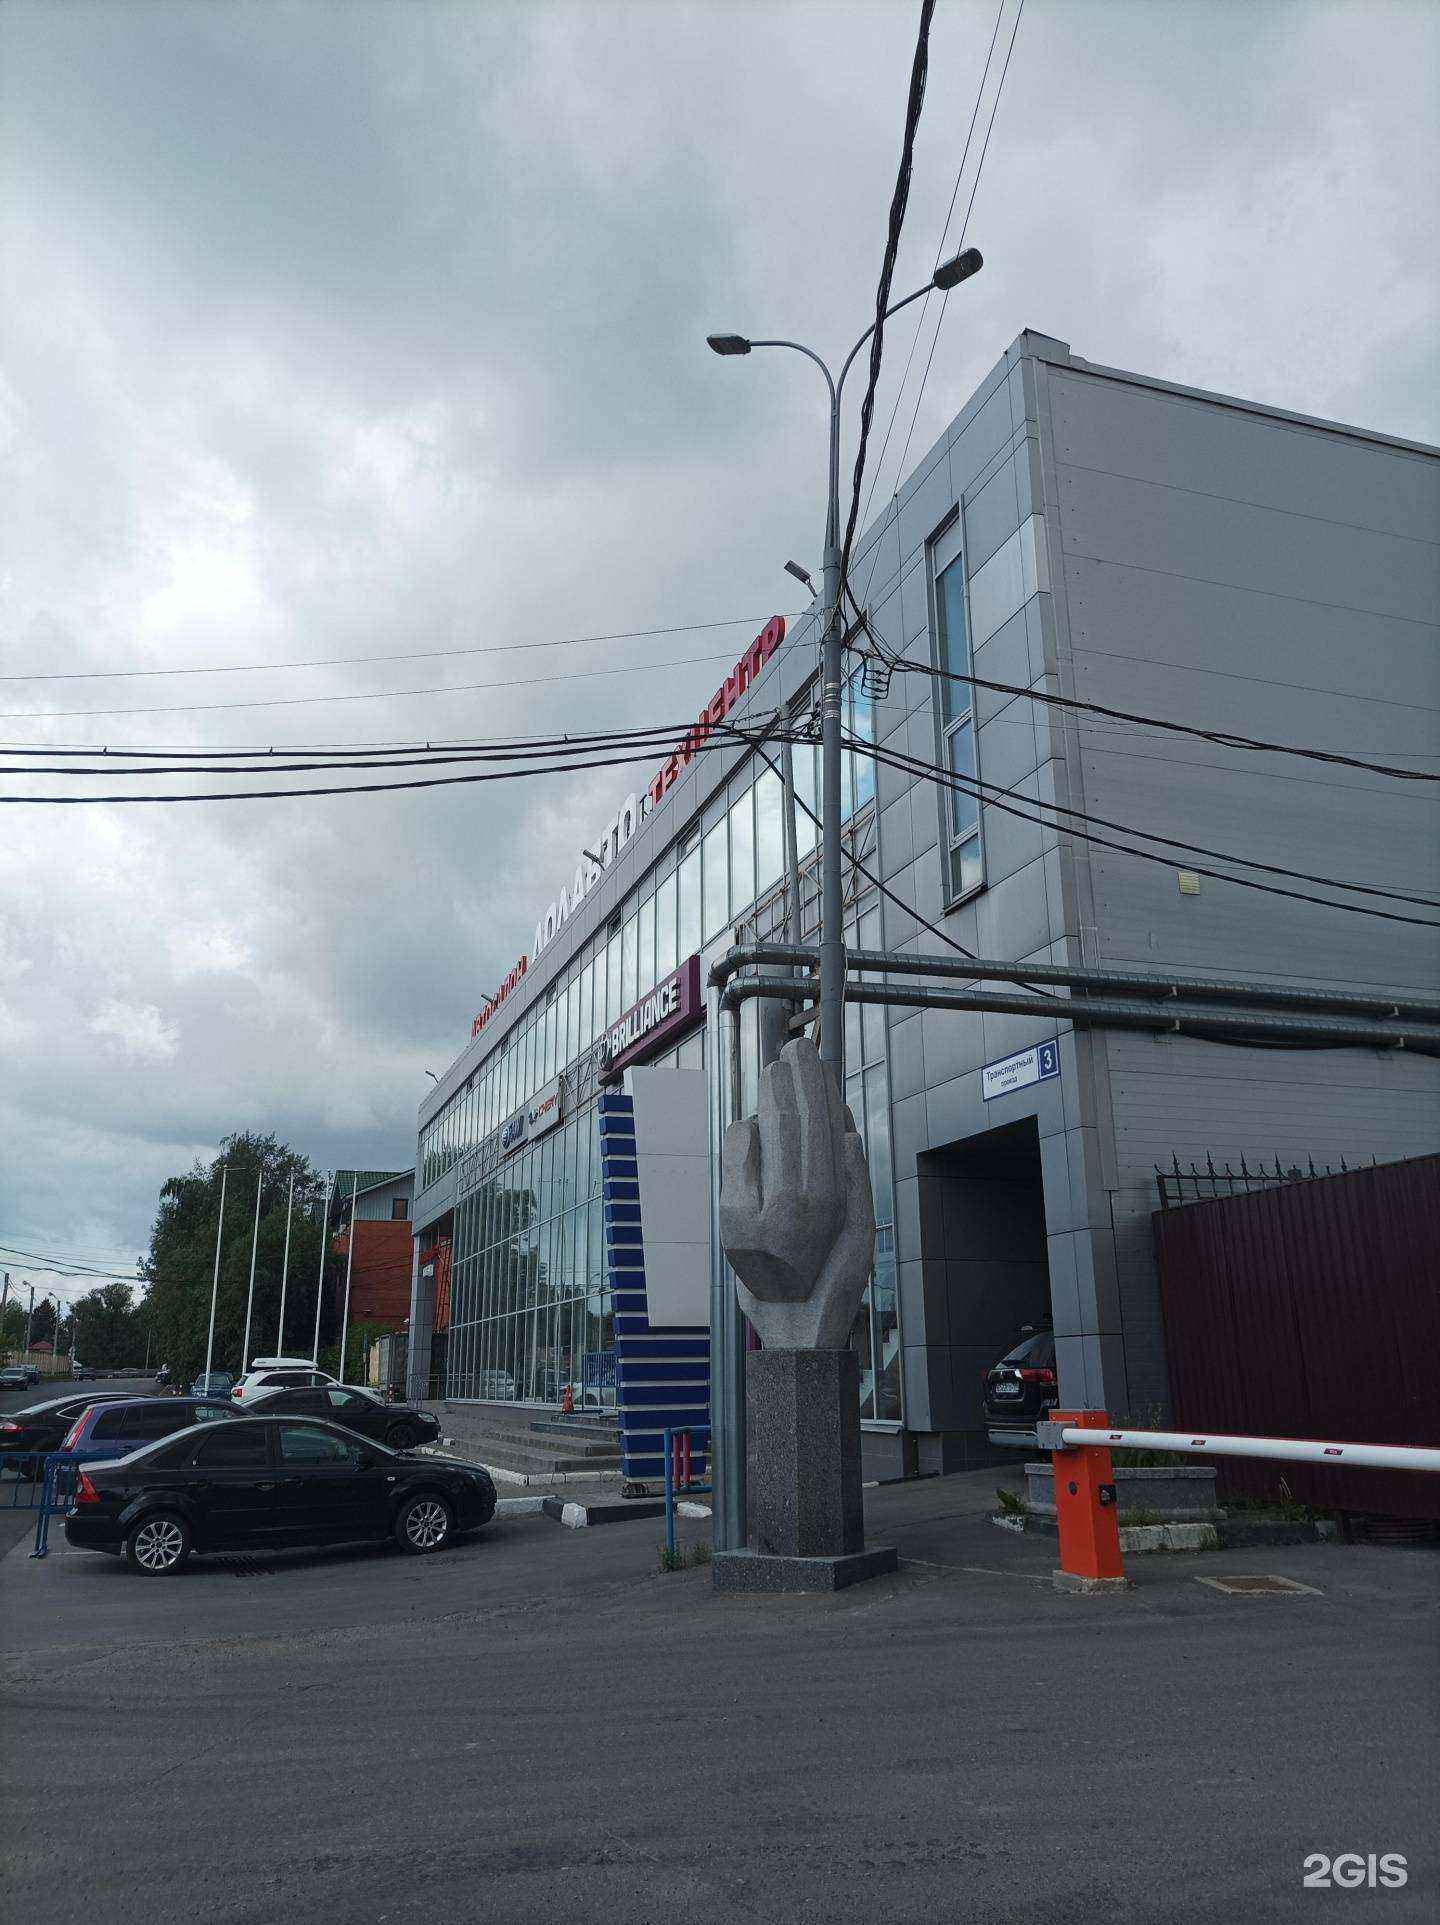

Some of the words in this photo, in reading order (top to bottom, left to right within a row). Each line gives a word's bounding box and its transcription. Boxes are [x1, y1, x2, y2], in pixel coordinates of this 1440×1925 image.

[612, 977, 681, 1059] BRILLIANCE
[986, 1055, 1034, 1082] Транспортный
[1044, 1049, 1052, 1069] 3
